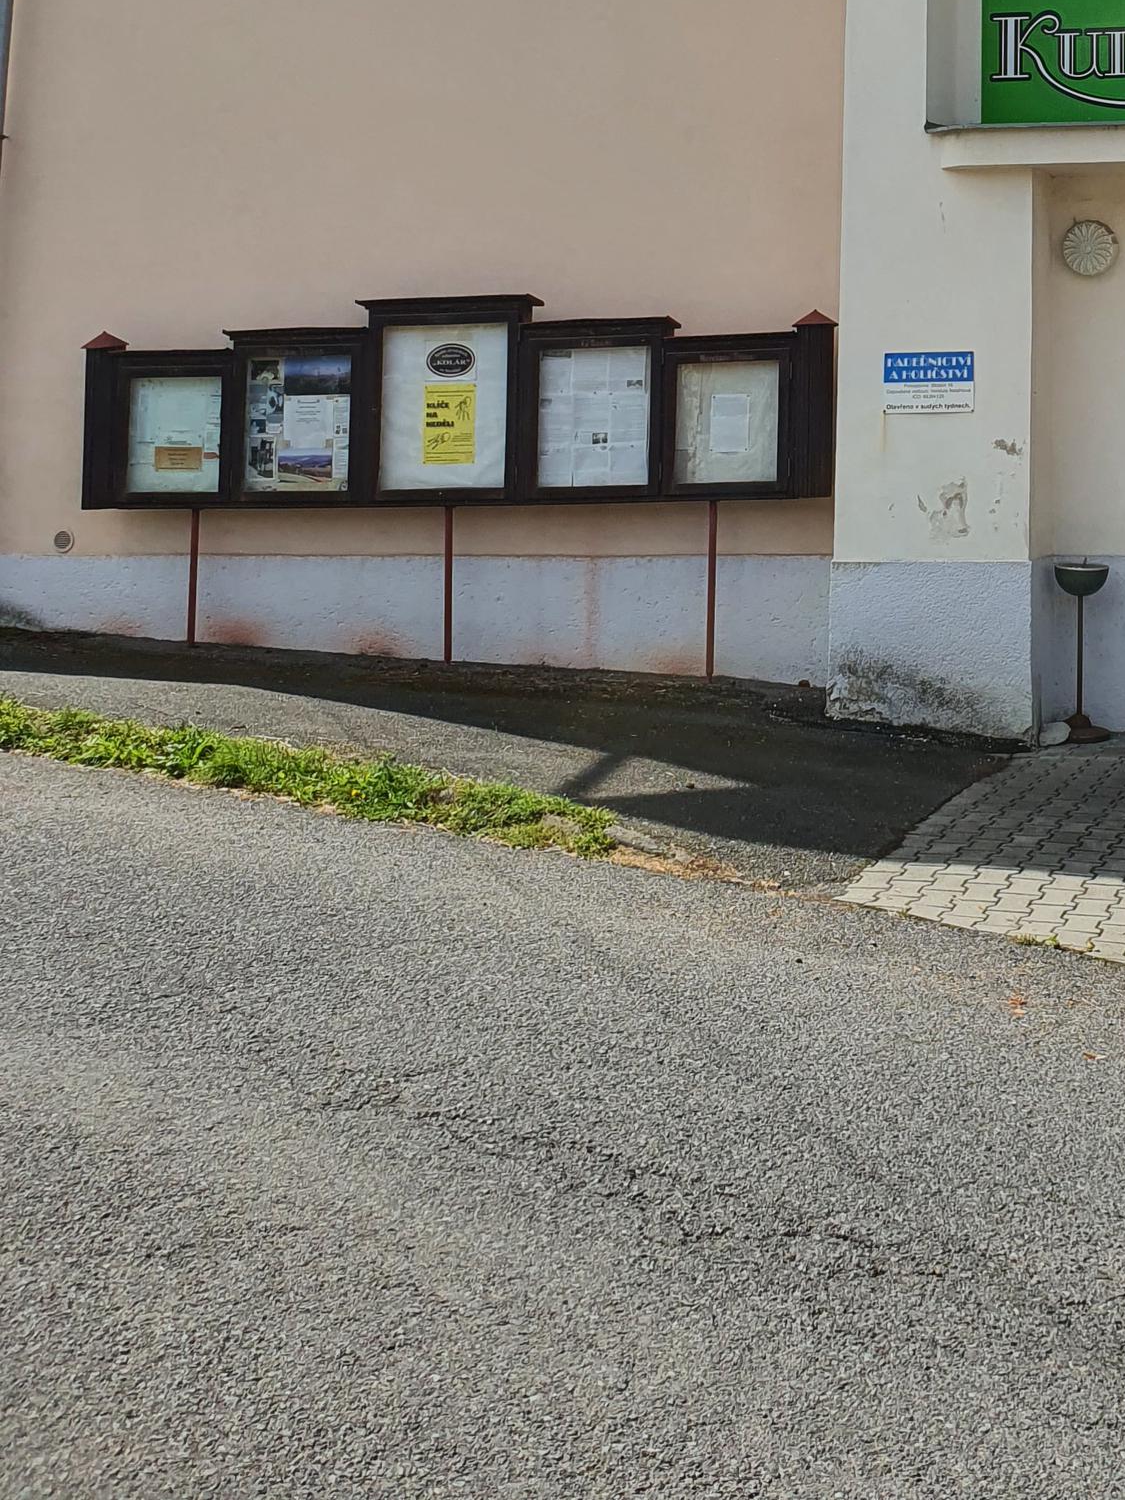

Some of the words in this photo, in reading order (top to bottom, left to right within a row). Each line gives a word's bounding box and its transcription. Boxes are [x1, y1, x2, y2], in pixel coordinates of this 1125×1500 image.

[887, 354, 971, 367] KADEŘNICTVÍ
[889, 369, 899, 380] A
[902, 366, 968, 380] HOLIČSTVÍ
